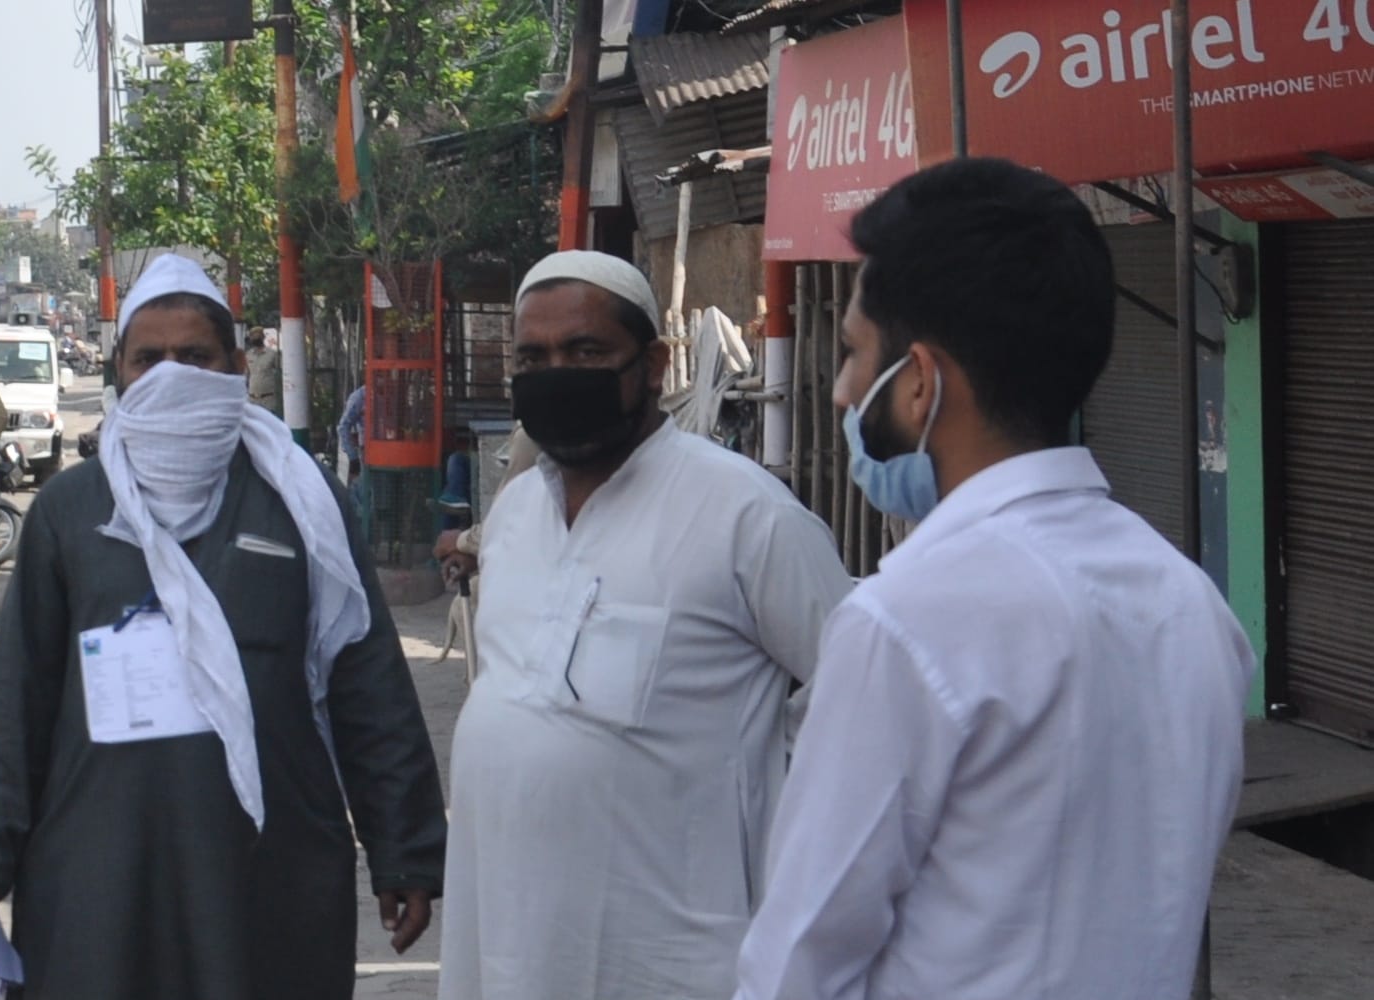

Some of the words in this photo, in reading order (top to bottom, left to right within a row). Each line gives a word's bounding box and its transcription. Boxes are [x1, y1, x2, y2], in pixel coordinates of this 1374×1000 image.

[806, 77, 870, 170] airtel
[878, 69, 915, 160] 4G
[1138, 95, 1174, 115] THE
[1189, 75, 1315, 108] MARTPHONE
